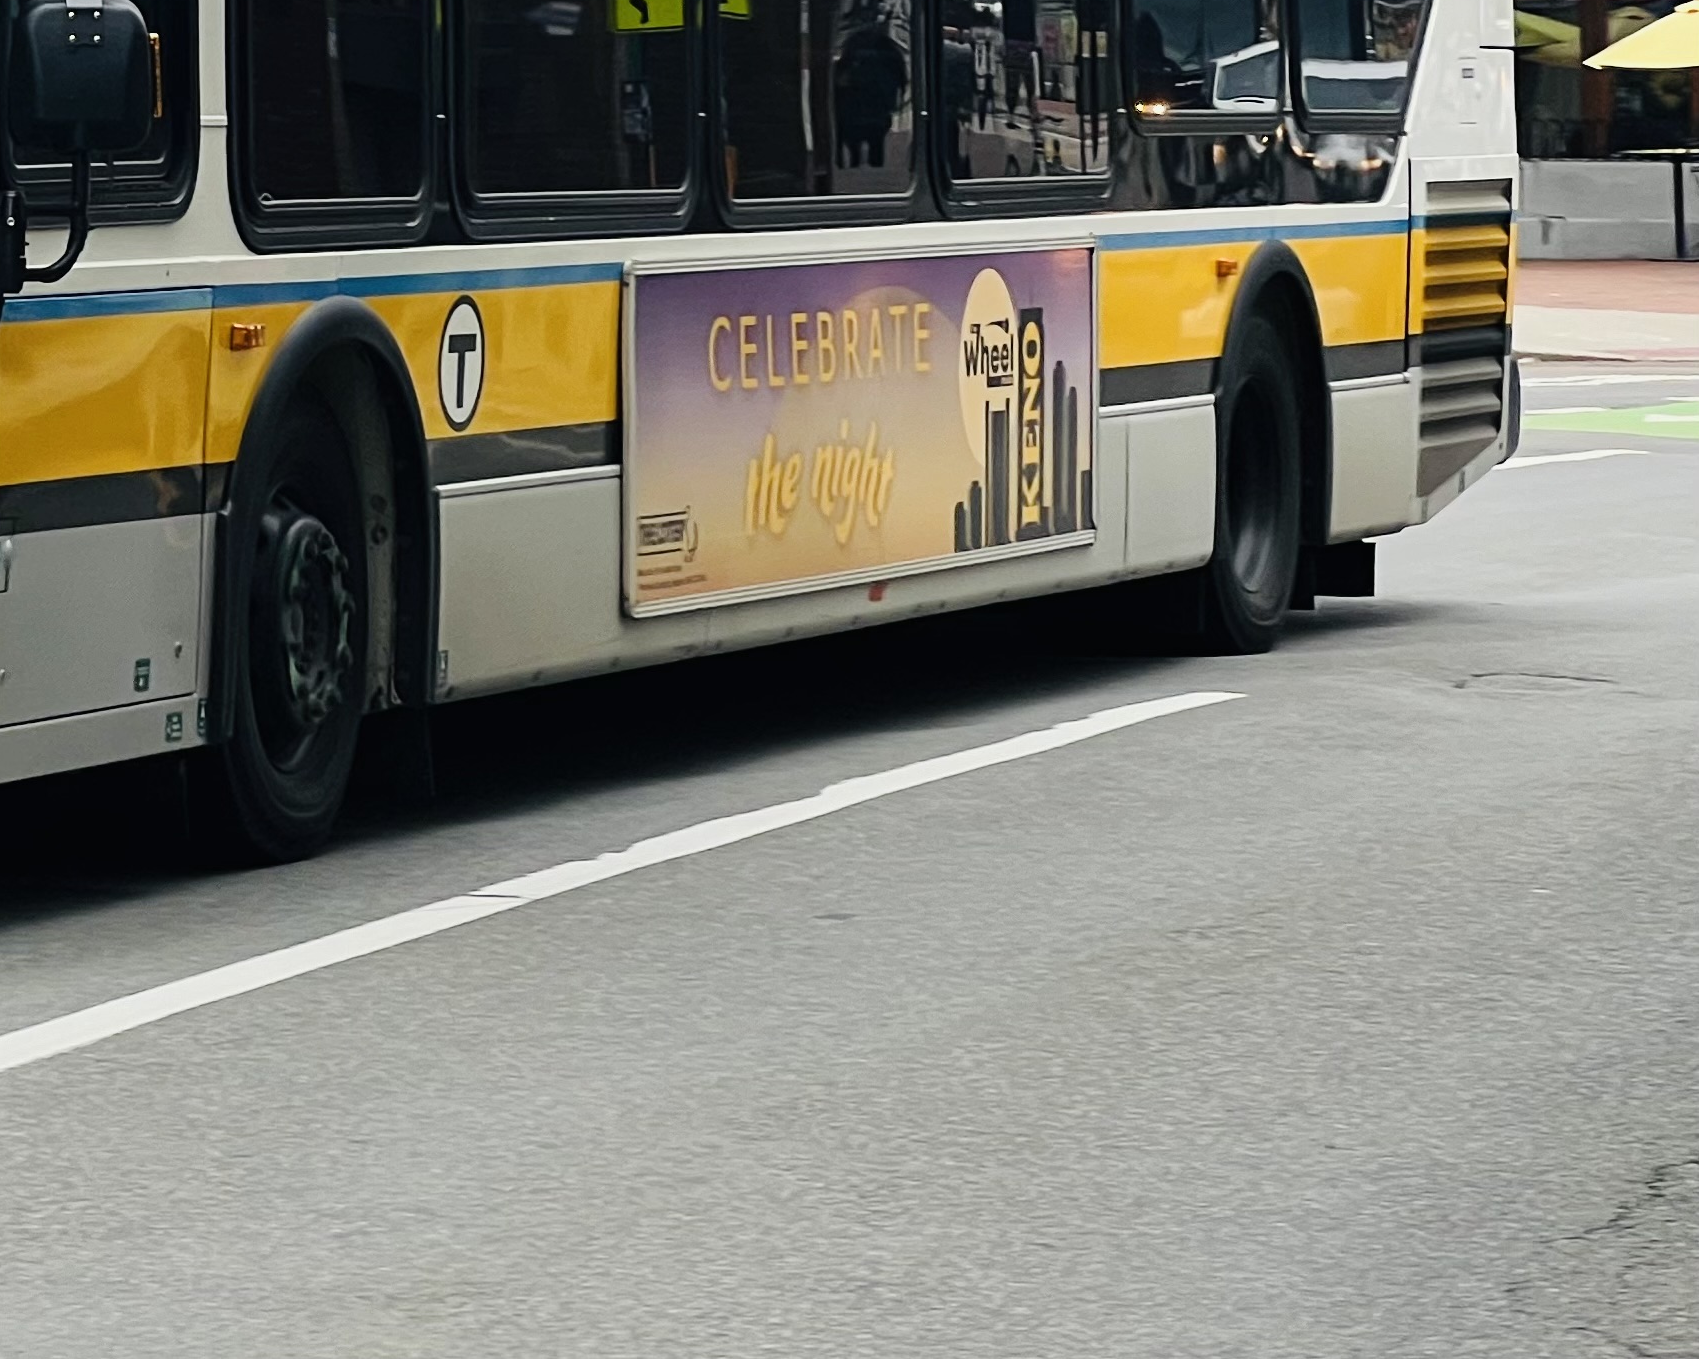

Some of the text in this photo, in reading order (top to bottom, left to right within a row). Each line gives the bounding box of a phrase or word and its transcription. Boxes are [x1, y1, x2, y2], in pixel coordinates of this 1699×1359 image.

[708, 301, 933, 392] CELEBRATE
[963, 321, 1014, 379] Wheel
[1022, 321, 1041, 524] KENO
[746, 418, 894, 545] the night
